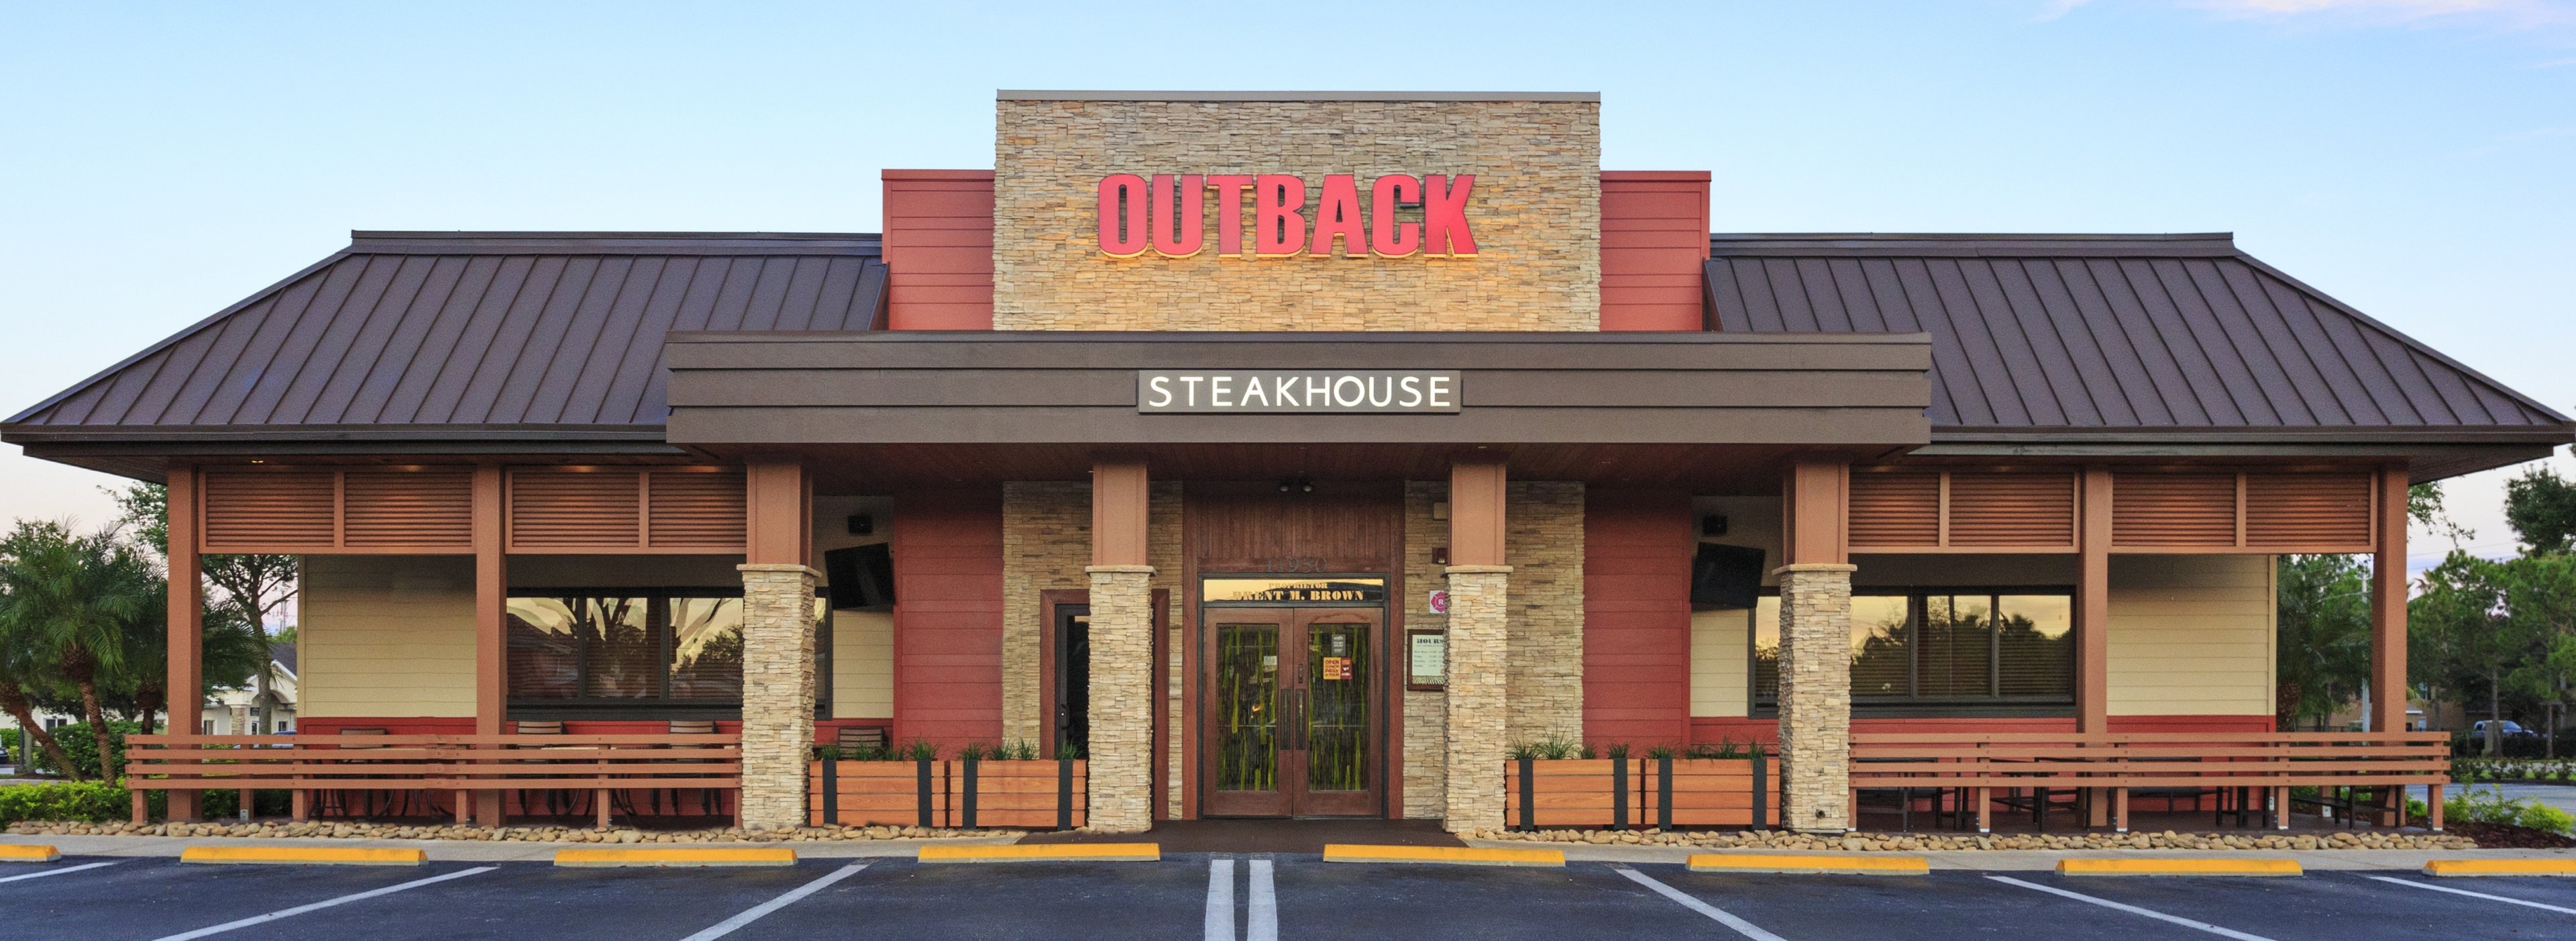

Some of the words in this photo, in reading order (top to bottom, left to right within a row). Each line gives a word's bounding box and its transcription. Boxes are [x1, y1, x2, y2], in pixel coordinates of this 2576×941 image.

[1098, 173, 1479, 258] OUTBACK
[1149, 376, 1450, 407] STEAKHOUSE
[1266, 558, 1328, 573] 11950
[1232, 591, 1284, 600] BRENT
[1289, 591, 1305, 600] M.
[1310, 591, 1364, 600] BROWN
